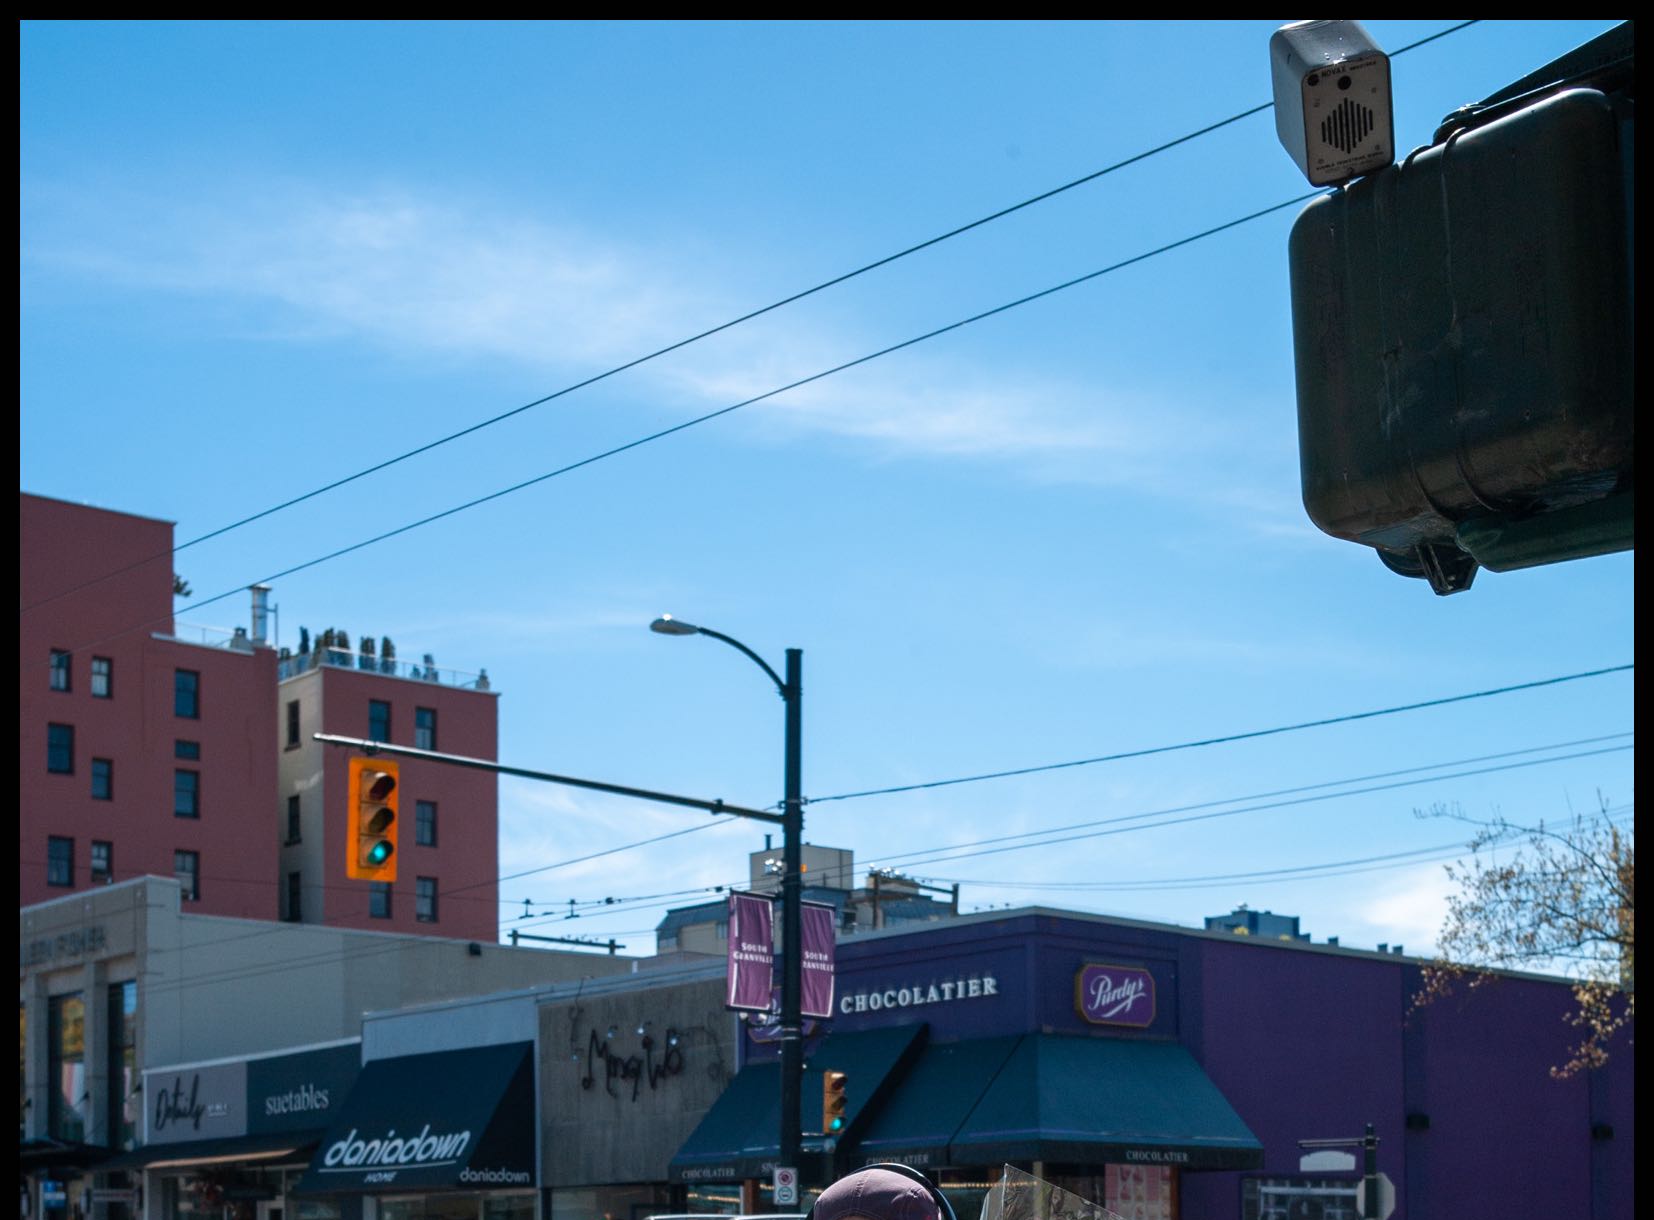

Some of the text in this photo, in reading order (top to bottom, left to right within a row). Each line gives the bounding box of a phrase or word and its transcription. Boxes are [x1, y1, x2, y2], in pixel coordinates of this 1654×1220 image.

[802, 960, 834, 972] RANVILLE
[840, 977, 998, 1014] CHOCOLATIER
[265, 1083, 330, 1116] suetables
[324, 1124, 471, 1167] daniadown
[1125, 1150, 1189, 1162] CHOCOLATIER
[364, 1171, 398, 1184] HOME
[459, 1166, 531, 1184] daniadown
[681, 1167, 737, 1179] CHOCOLATIER
